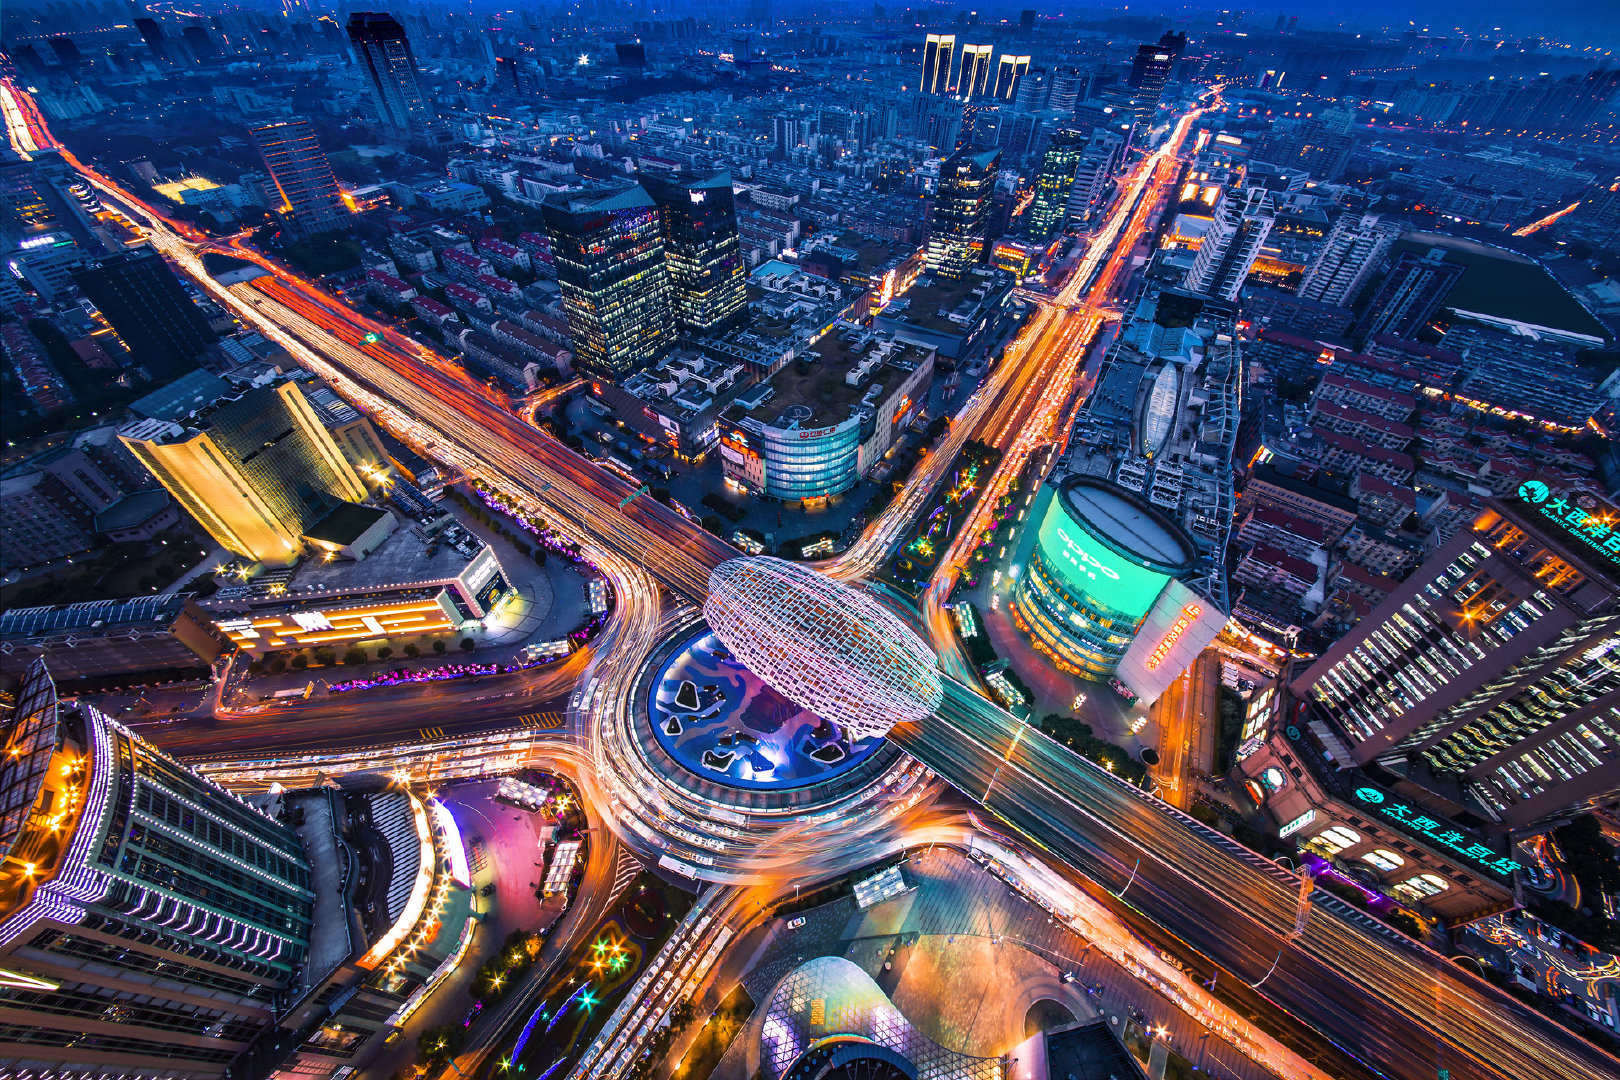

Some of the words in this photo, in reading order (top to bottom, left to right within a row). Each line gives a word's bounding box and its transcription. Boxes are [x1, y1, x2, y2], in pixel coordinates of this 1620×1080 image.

[1539, 508, 1570, 529] ATLANTIC
[1568, 527, 1613, 557] DEPARTMENT
[1380, 808, 1421, 831] ATLANTIC
[1421, 830, 1479, 859] DEPARTMENT
[1386, 803, 1521, 872] 大西洋百货
